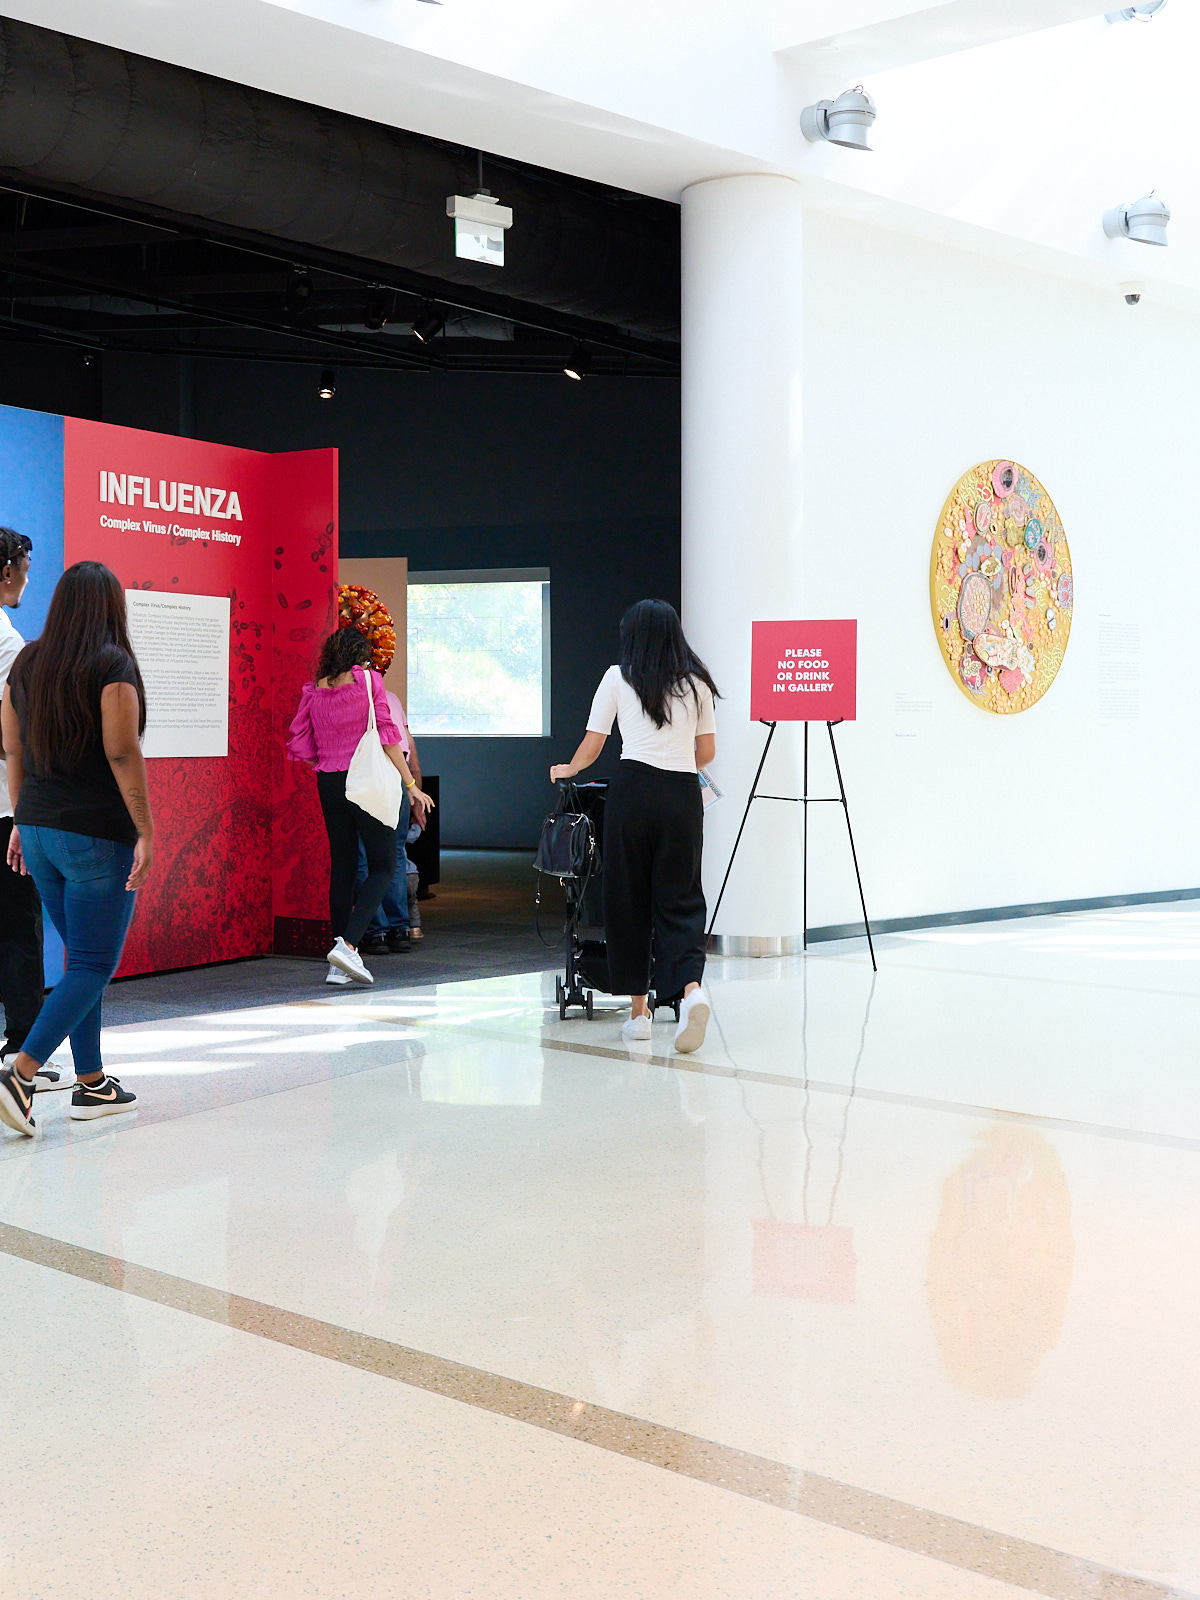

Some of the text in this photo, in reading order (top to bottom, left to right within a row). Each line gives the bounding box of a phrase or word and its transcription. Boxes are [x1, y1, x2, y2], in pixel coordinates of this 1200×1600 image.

[100, 471, 243, 521] INFLUENZA
[100, 515, 241, 546] Complex Virus / Complex History
[785, 649, 822, 657] PLEASE
[778, 661, 829, 669] NO FOOD
[777, 672, 830, 680] OR DRINK
[773, 684, 834, 692] IN GALLERY
